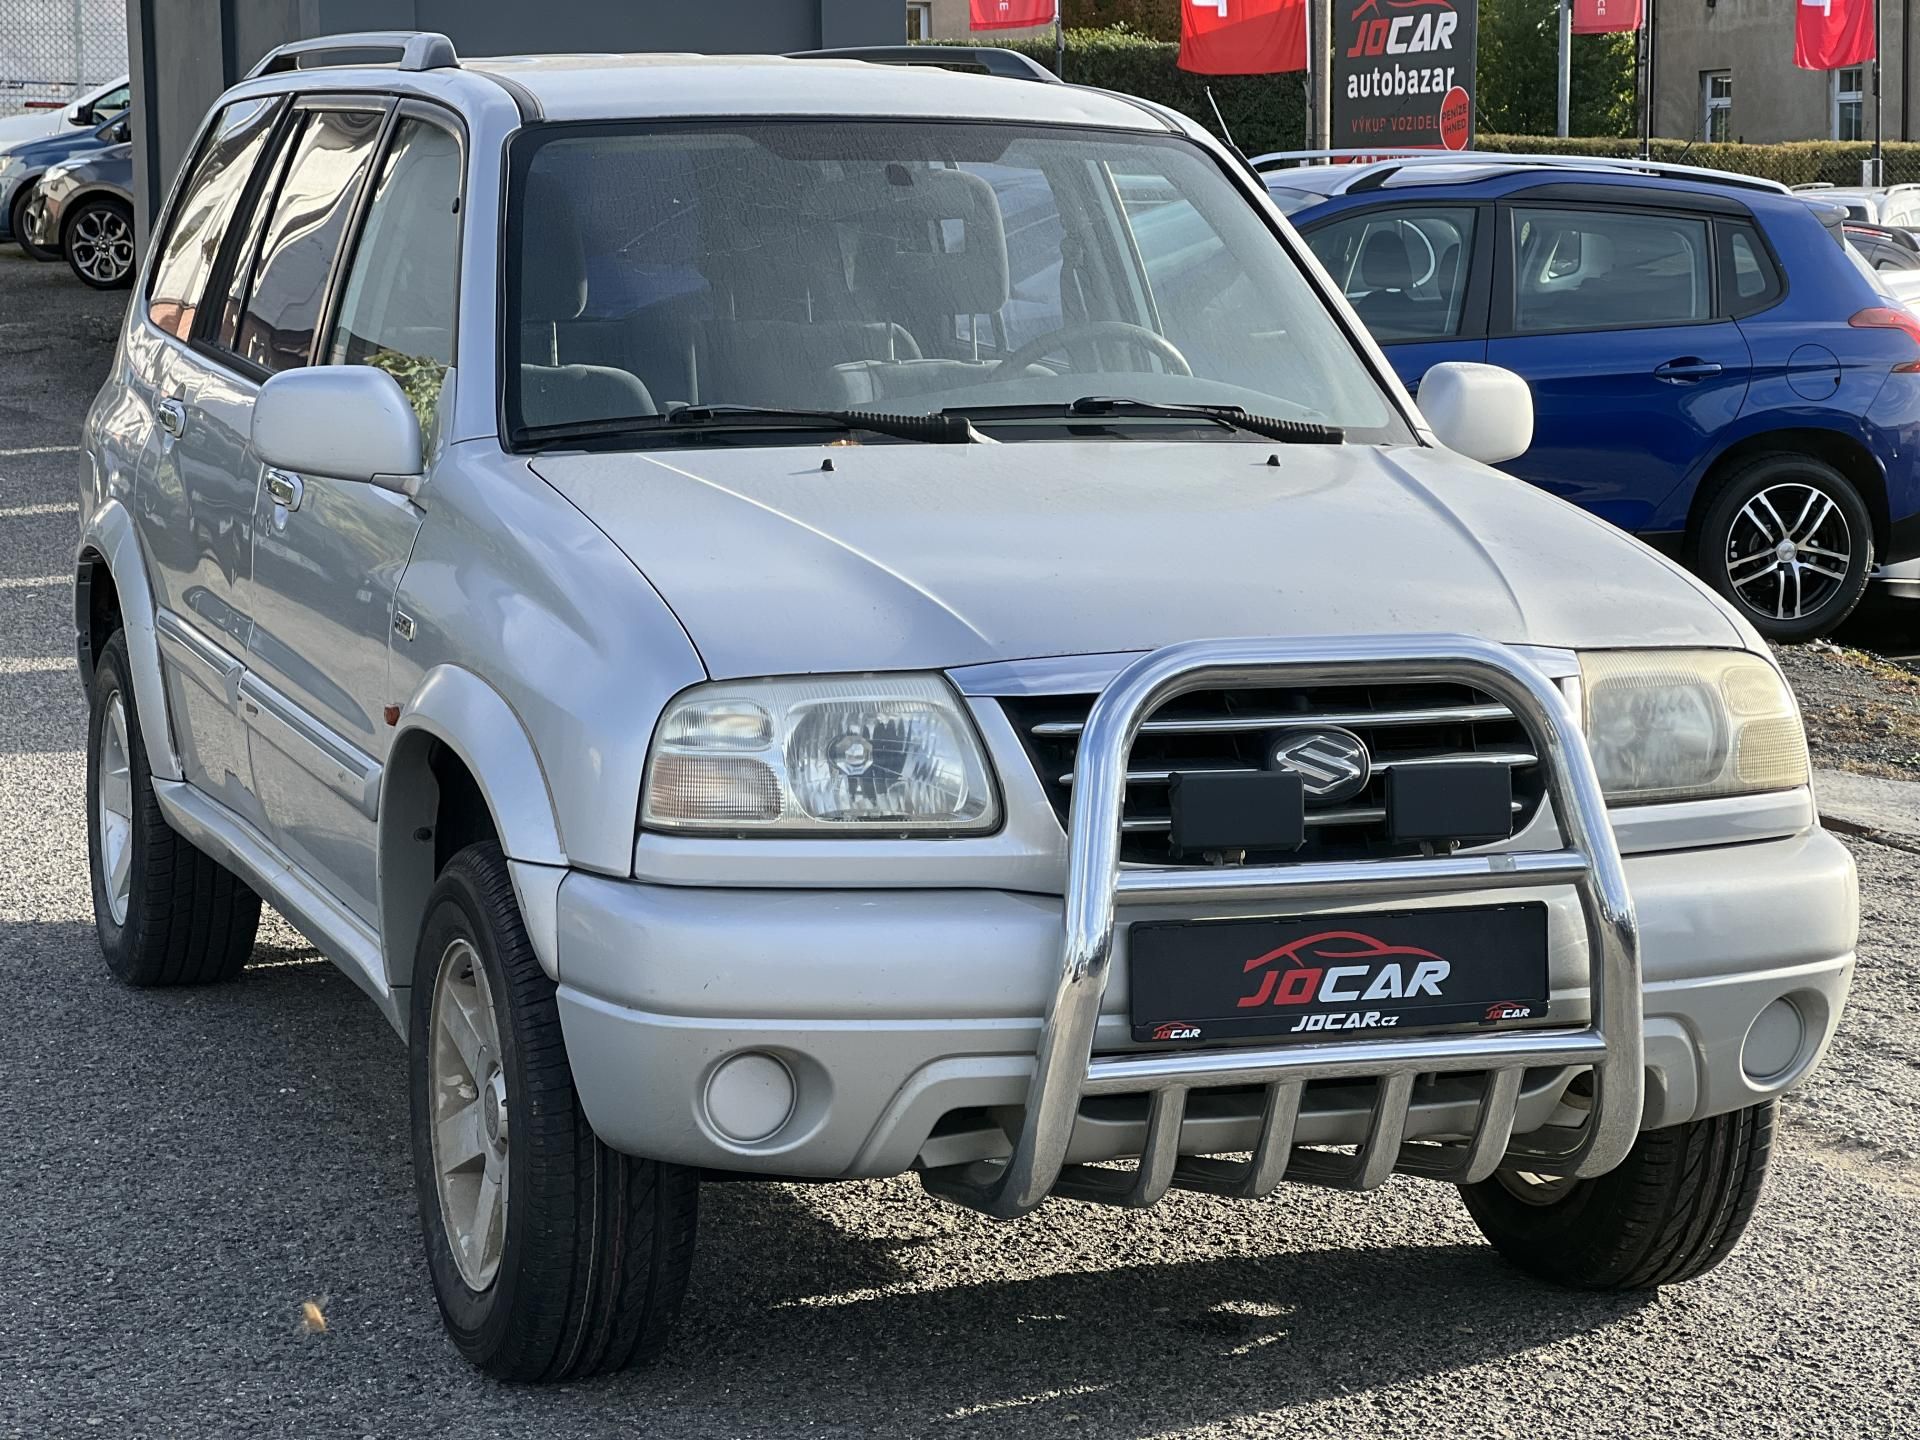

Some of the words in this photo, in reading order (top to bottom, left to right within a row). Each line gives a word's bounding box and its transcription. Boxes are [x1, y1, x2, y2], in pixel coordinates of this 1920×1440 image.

[1347, 11, 1458, 58] JOCAR
[1347, 64, 1455, 99] autobazar
[1391, 115, 1438, 131] VOZIDEL
[1444, 120, 1466, 135] IHNED
[1236, 960, 1451, 1008] JOCAR
[1485, 1008, 1530, 1019] JOCAR
[1152, 1028, 1201, 1040] JOCAR
